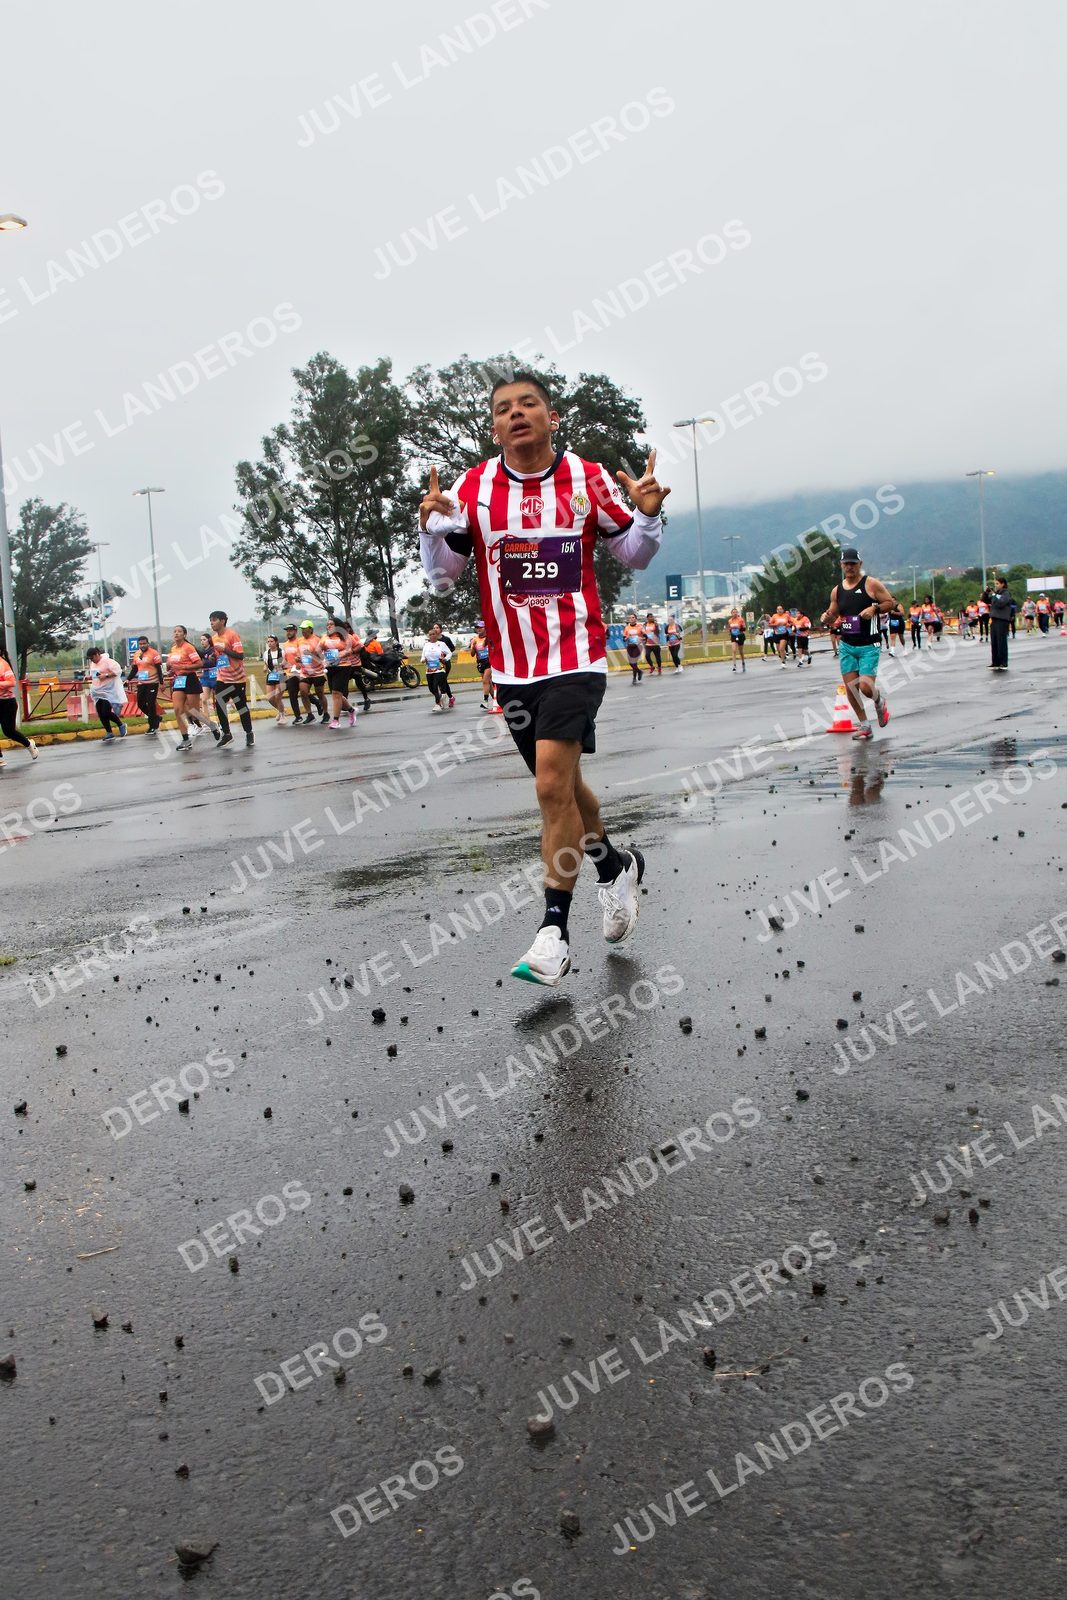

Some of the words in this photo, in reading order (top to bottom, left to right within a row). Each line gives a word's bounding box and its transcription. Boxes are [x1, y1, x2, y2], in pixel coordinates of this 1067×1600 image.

[520, 497, 543, 515] MG
[504, 542, 539, 552] CARRERA
[522, 562, 559, 579] 259
[669, 585, 678, 597] E
[530, 598, 550, 607] pago
